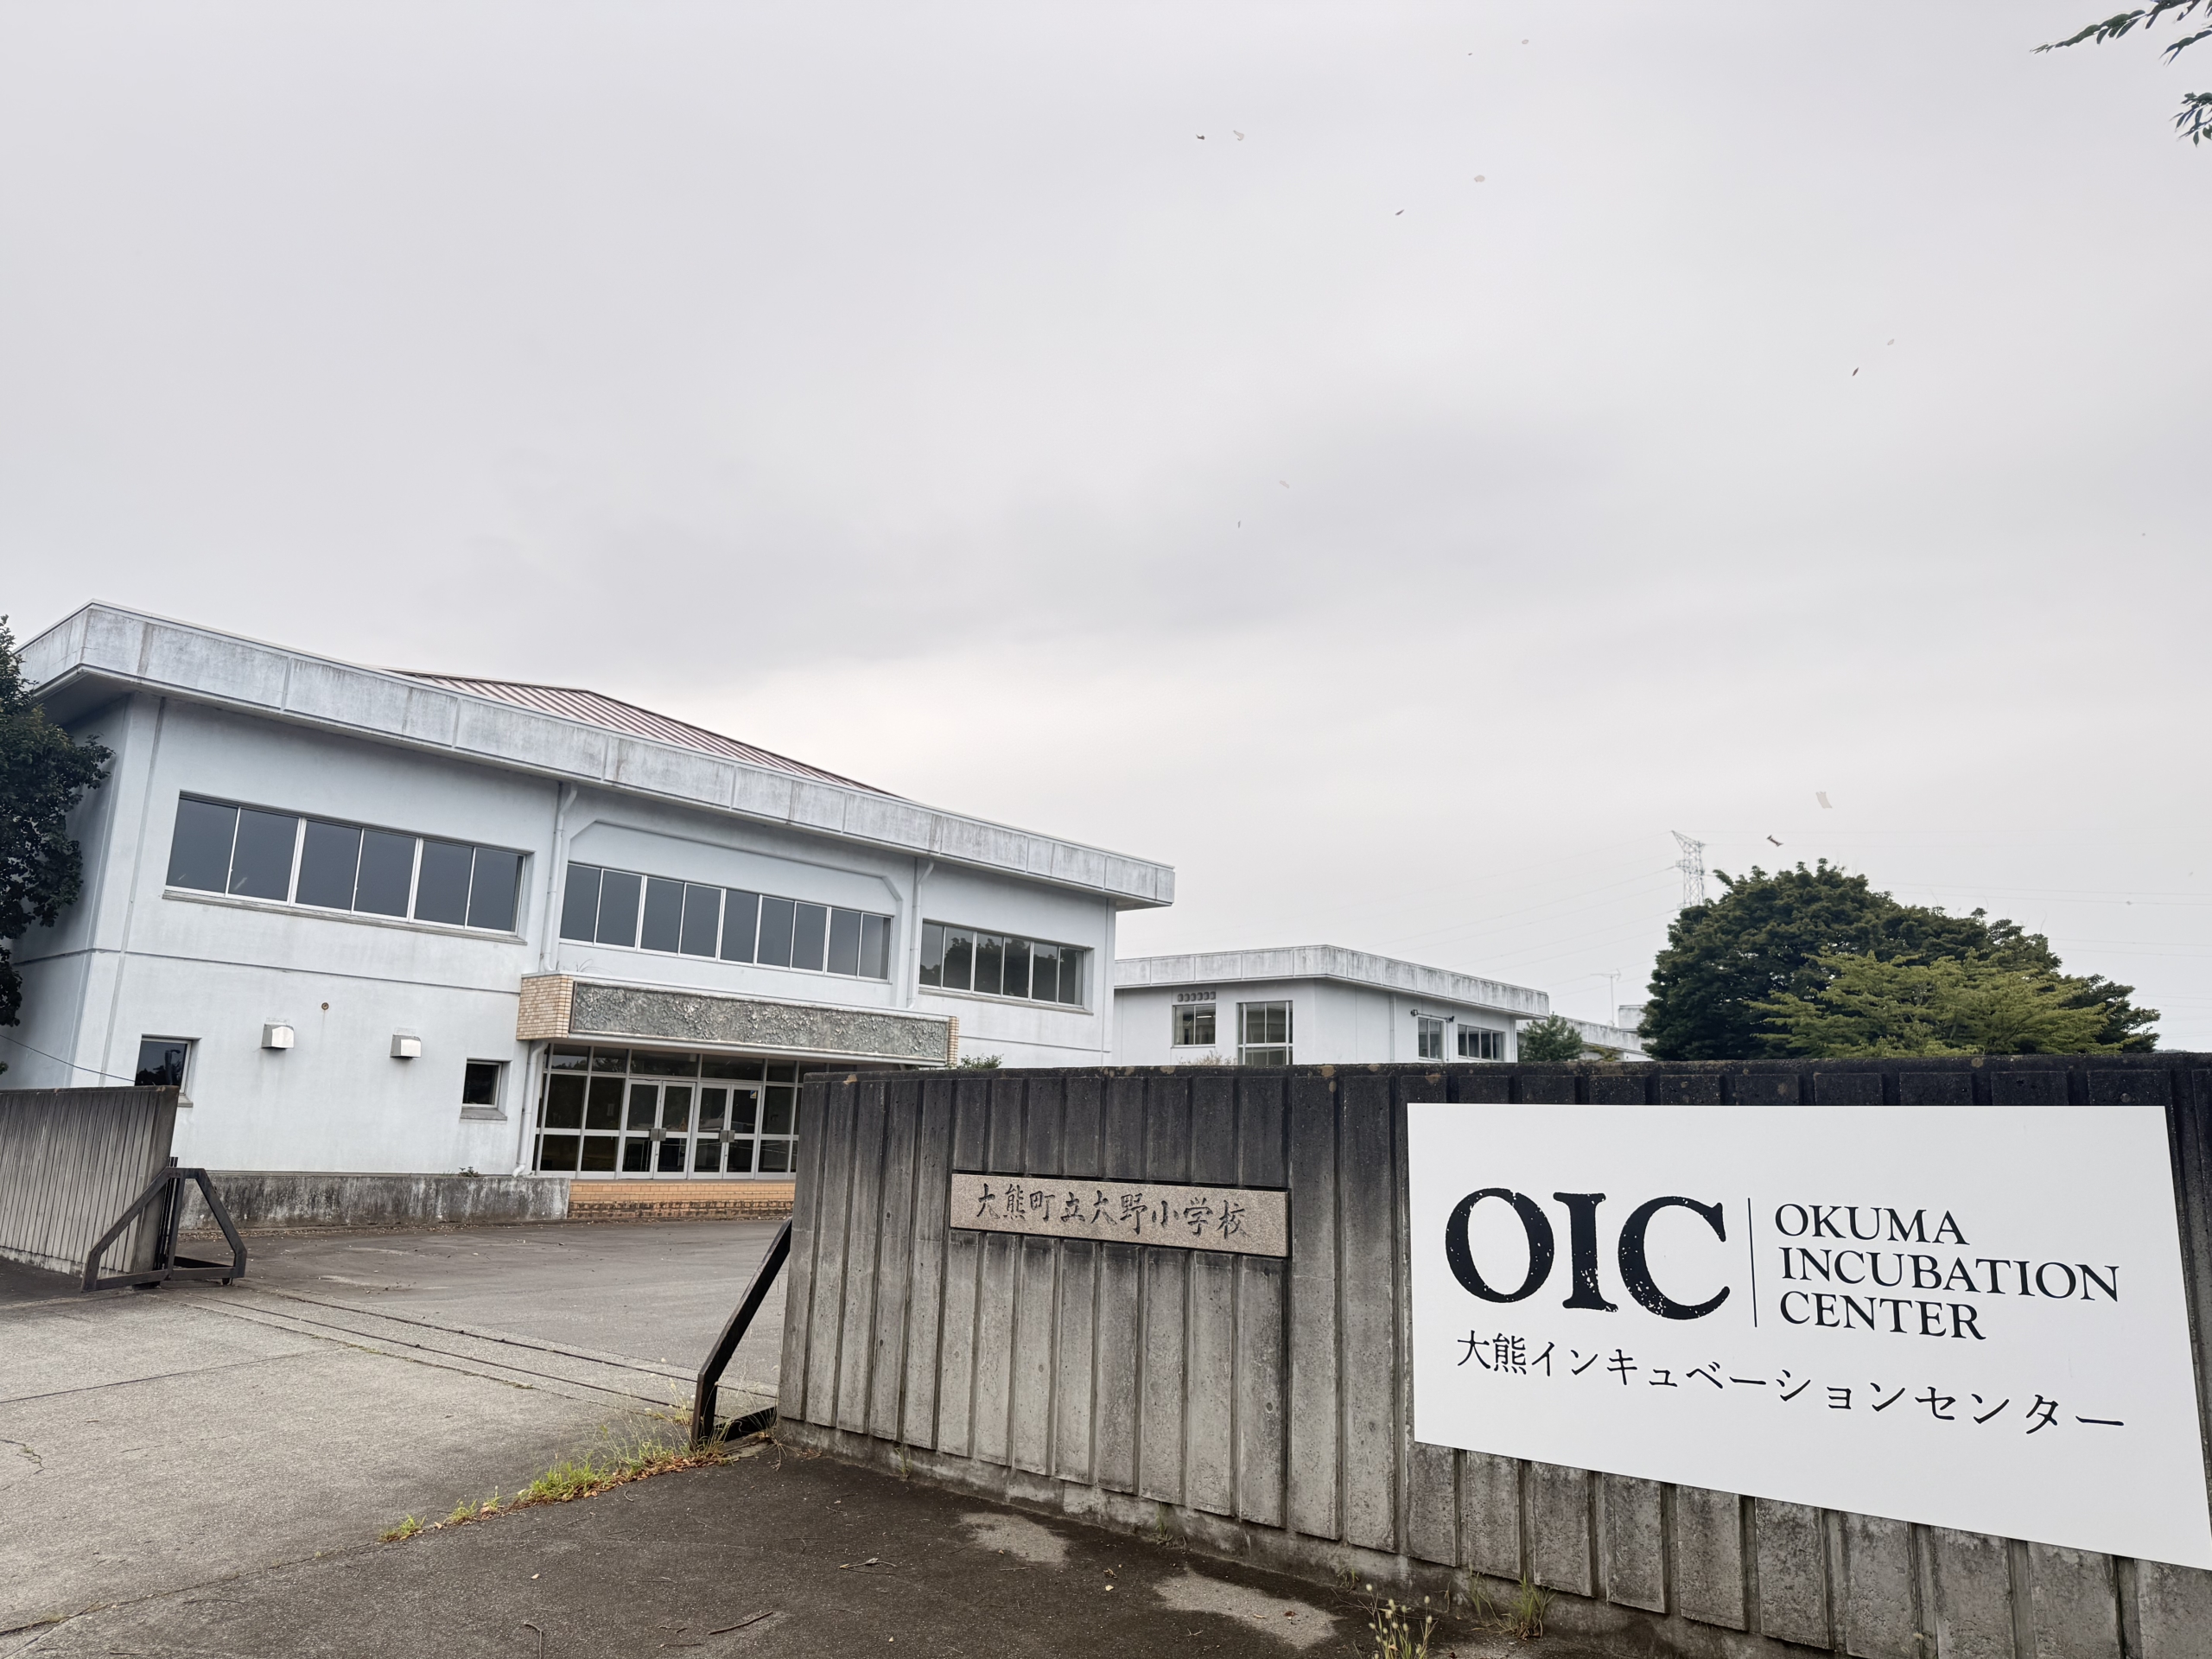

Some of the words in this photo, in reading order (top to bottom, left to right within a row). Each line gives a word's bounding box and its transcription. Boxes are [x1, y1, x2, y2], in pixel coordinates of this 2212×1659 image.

[976, 1182, 1250, 1240] 大熊町立大野小学校
[1775, 1204, 1970, 1246] OKUMA
[1445, 1187, 1731, 1320] OIC
[1778, 1246, 2120, 1302] INCUBATION
[1780, 1290, 1986, 1340] CENTER
[1456, 1330, 2125, 1434] 大熊インキュベーションセンター
